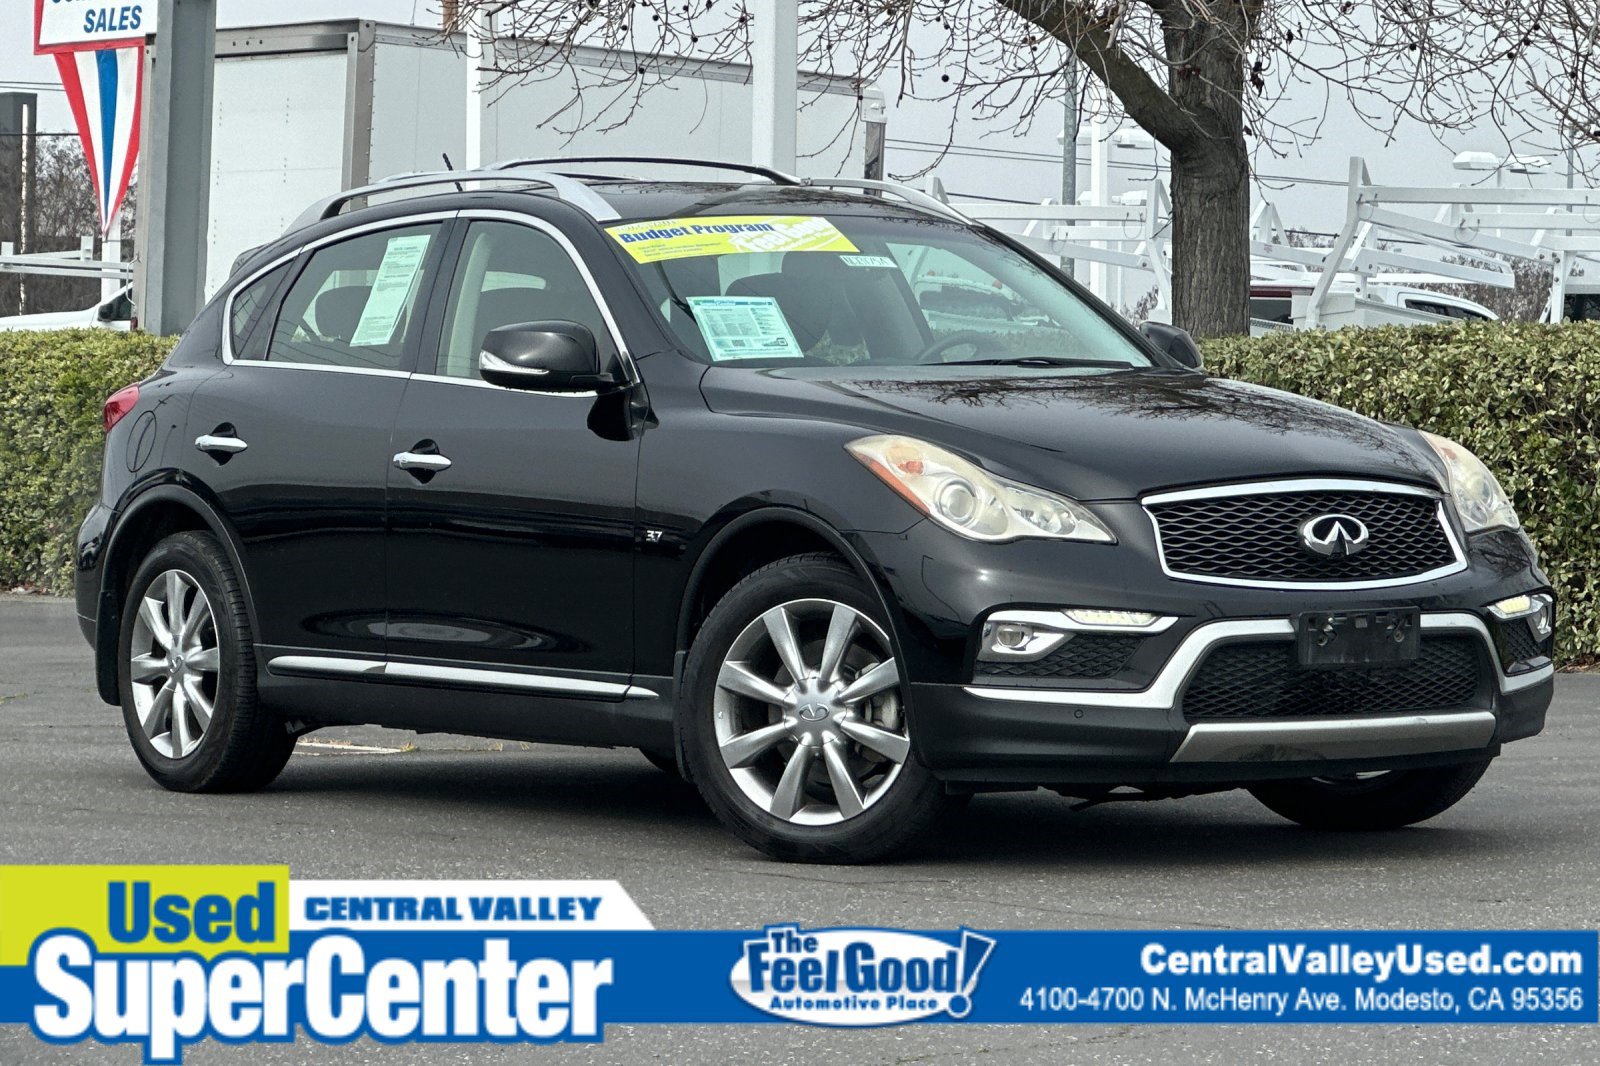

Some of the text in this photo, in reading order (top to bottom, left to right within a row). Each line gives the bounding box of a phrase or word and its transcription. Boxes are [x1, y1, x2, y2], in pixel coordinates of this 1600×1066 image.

[83, 5, 143, 33] SALES
[618, 226, 693, 243] Budget
[692, 223, 775, 235] Program
